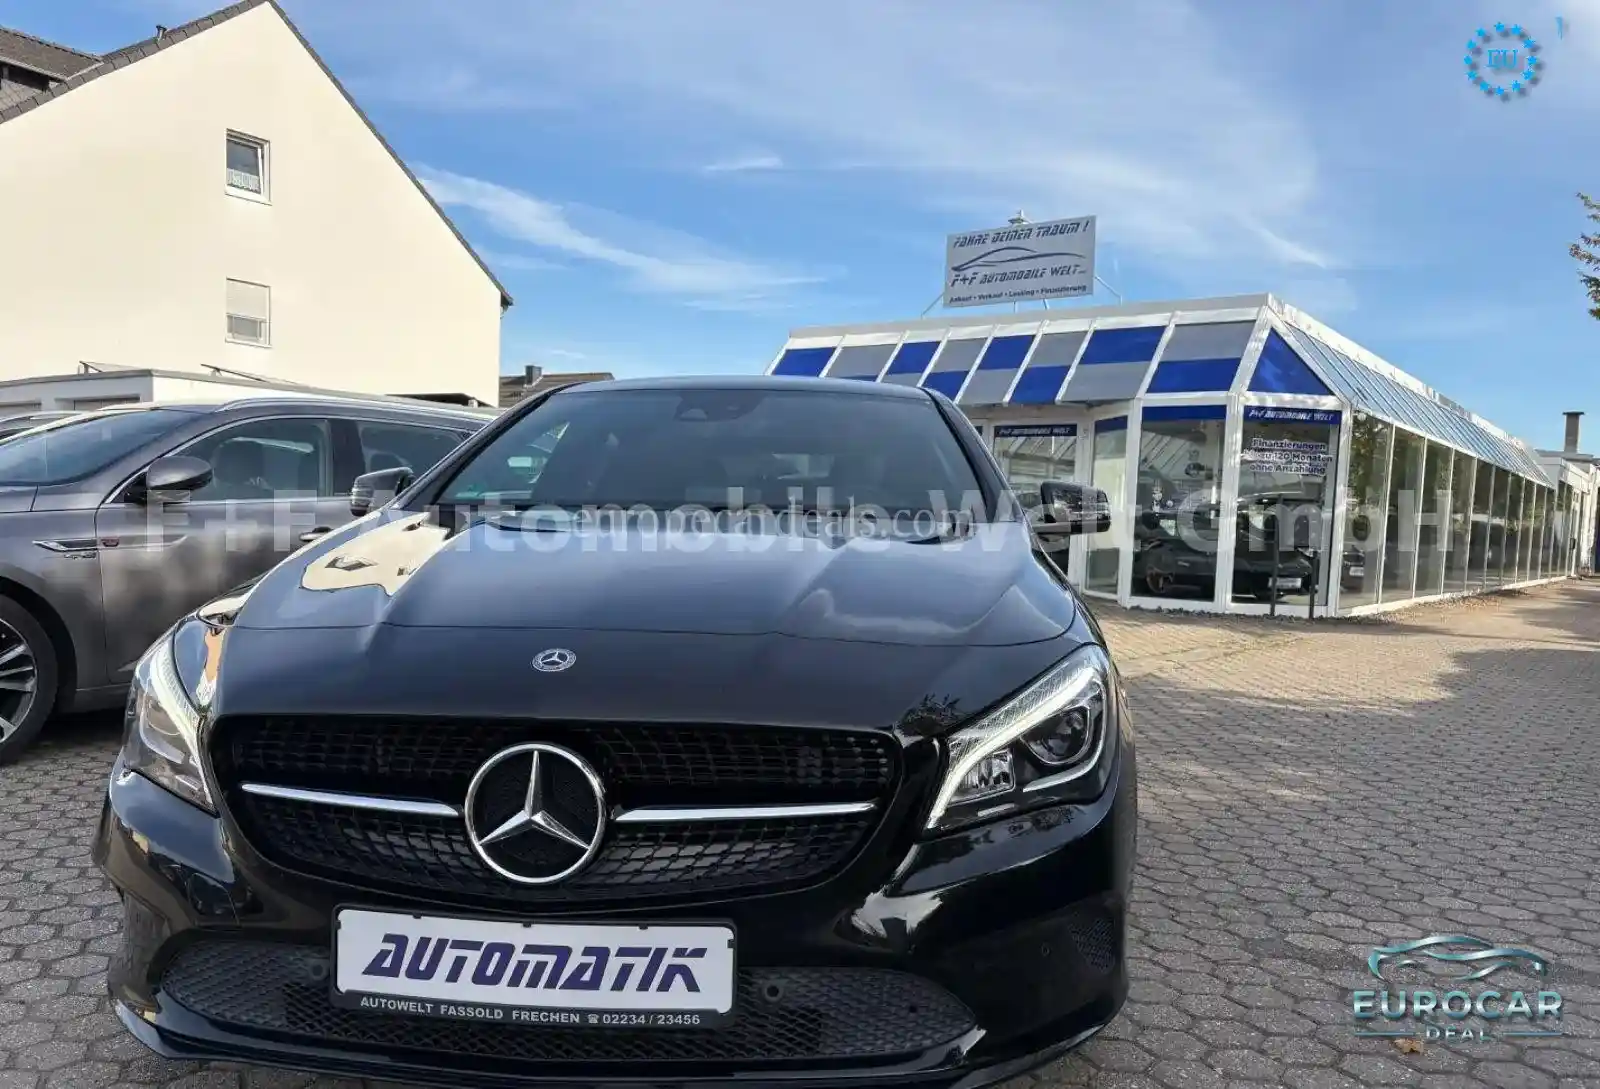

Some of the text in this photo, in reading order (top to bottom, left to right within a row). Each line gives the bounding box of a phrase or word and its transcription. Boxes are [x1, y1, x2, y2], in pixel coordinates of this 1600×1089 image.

[951, 263, 1081, 287] F+F AUTOMOBILE WELT
[1040, 285, 1087, 295] Finanzierung
[1252, 439, 1327, 451] Finanzierungen
[361, 932, 707, 993] AUTOMATIK
[360, 996, 434, 1015] AUTOWELT
[439, 1004, 504, 1020] FASSOLD
[511, 1009, 580, 1025] FRECHEN
[602, 1012, 646, 1026] 02234
[656, 1013, 701, 1026] 23456
